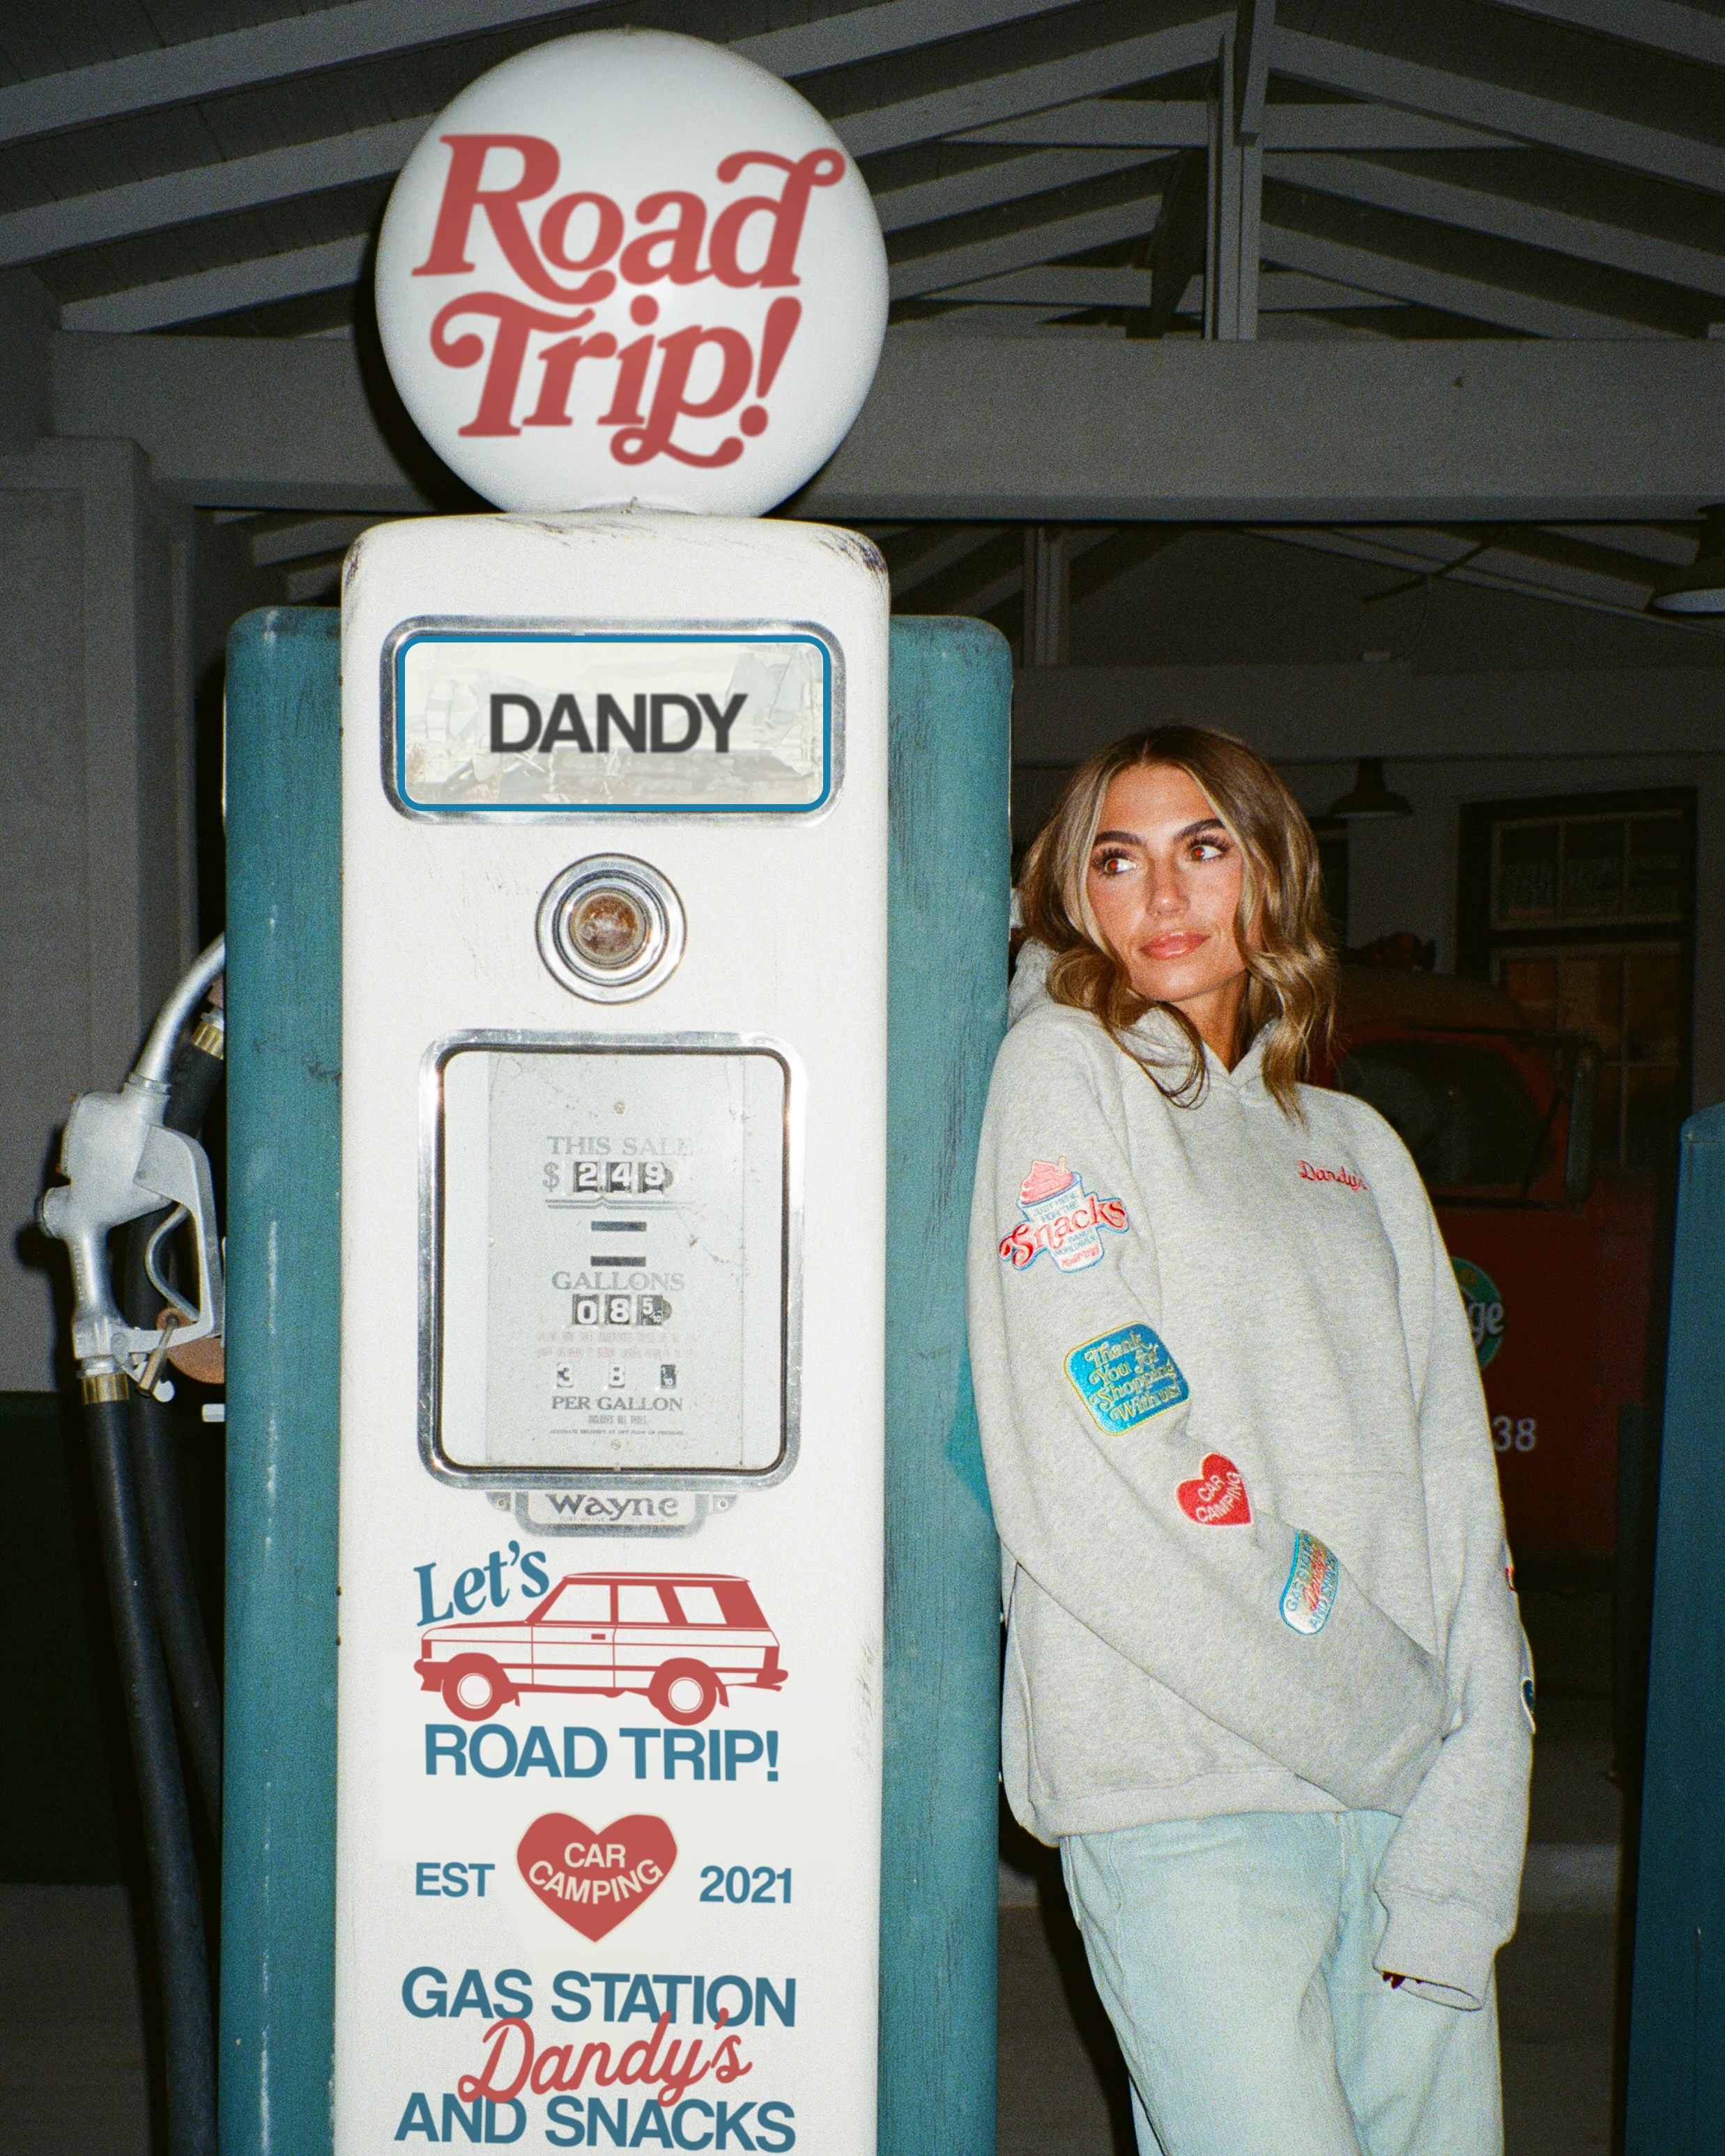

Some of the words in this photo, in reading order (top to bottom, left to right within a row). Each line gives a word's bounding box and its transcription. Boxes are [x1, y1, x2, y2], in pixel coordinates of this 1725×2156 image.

[411, 134, 846, 305] Road
[430, 292, 802, 468] Trip!
[489, 693, 748, 753] DANDY
[546, 1136, 611, 1155] THIS
[622, 1137, 693, 1156] SALE
[999, 1195, 1126, 1268] Snacks
[551, 1270, 685, 1291] GALLONS
[1084, 1331, 1154, 1369] Thank
[1089, 1361, 1133, 1386] You
[1089, 1358, 1178, 1412] Shopping
[551, 1396, 591, 1410] PER
[597, 1396, 684, 1410] GALLON
[1109, 1389, 1158, 1422] With
[545, 1493, 679, 1521] Wayne
[1196, 1472, 1243, 1522] CAMPING
[1198, 1474, 1225, 1502] CAR
[413, 1540, 550, 1626] Let's
[1286, 1580, 1307, 1612] GAS
[1309, 1597, 1328, 1628] AND
[425, 1724, 608, 1778] ROAD
[619, 1727, 779, 1782] TRIP!
[564, 1842, 627, 1868] CAR
[415, 1862, 496, 1897] EST
[528, 1859, 664, 1905] CAMPING
[699, 1865, 792, 1904] 2021
[401, 1966, 534, 2019] GAS
[551, 1971, 797, 2027] STATION
[457, 2008, 753, 2107] Dandy's
[394, 2093, 527, 2144] AND
[545, 2095, 796, 2153] SNACKS
